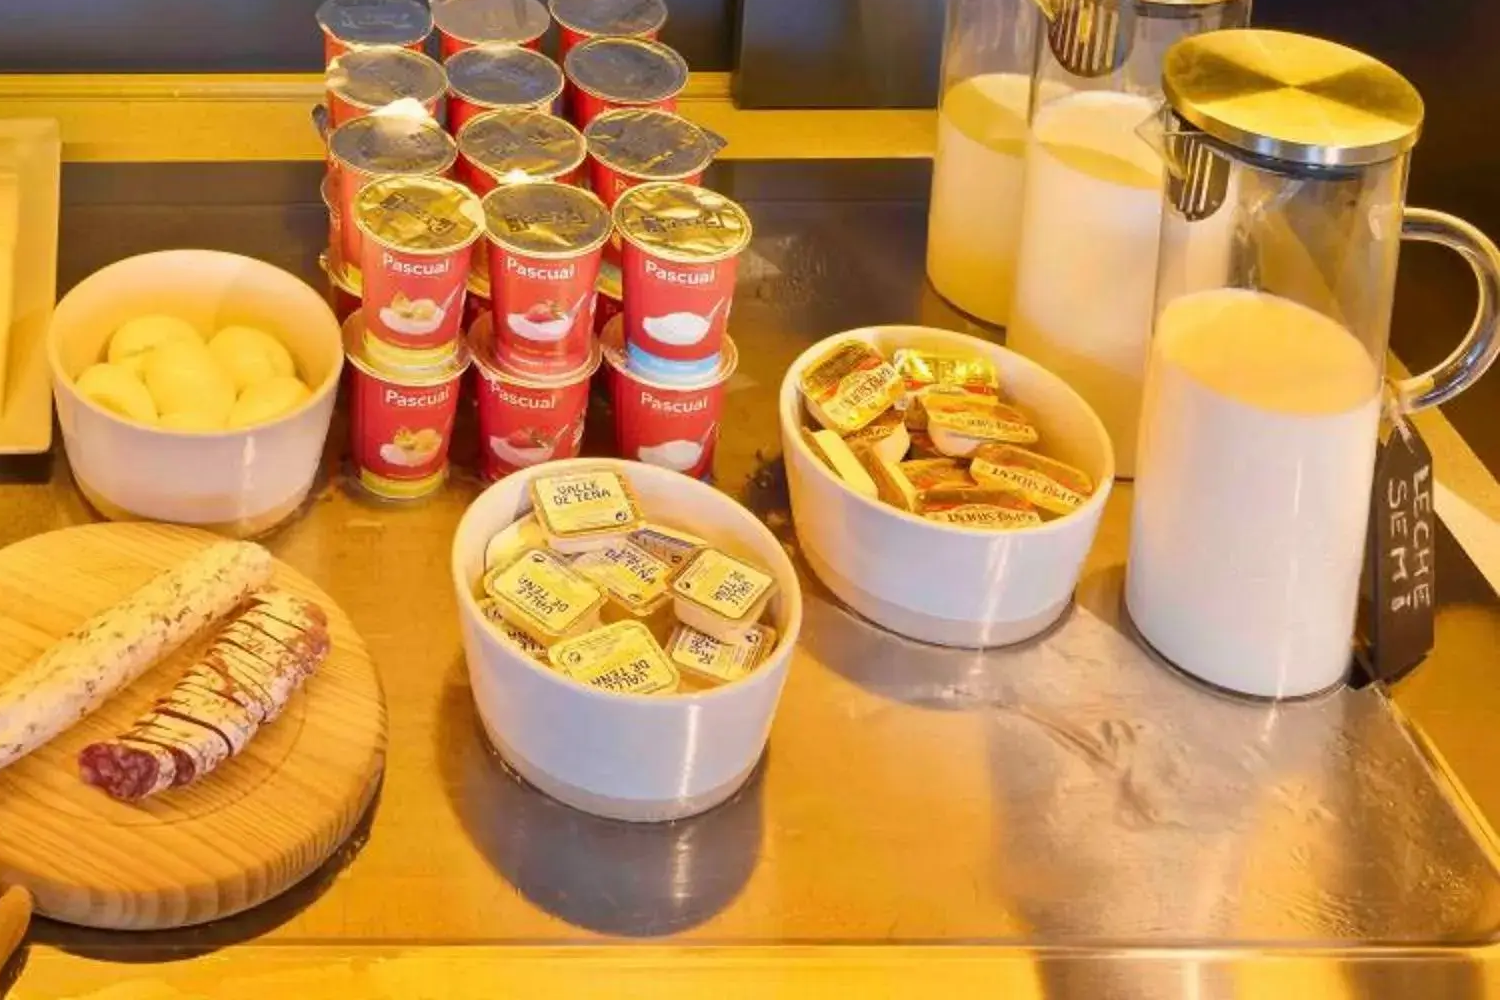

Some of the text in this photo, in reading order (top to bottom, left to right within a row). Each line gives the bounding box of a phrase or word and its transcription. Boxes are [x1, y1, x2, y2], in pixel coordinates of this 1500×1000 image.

[382, 253, 449, 276] Pascual
[506, 256, 575, 280] Pascual
[643, 260, 716, 286] Pascual
[385, 387, 449, 408] Pascual
[490, 382, 557, 409] Pascual
[640, 391, 709, 414] Pascual
[1412, 463, 1431, 611] LECHE
